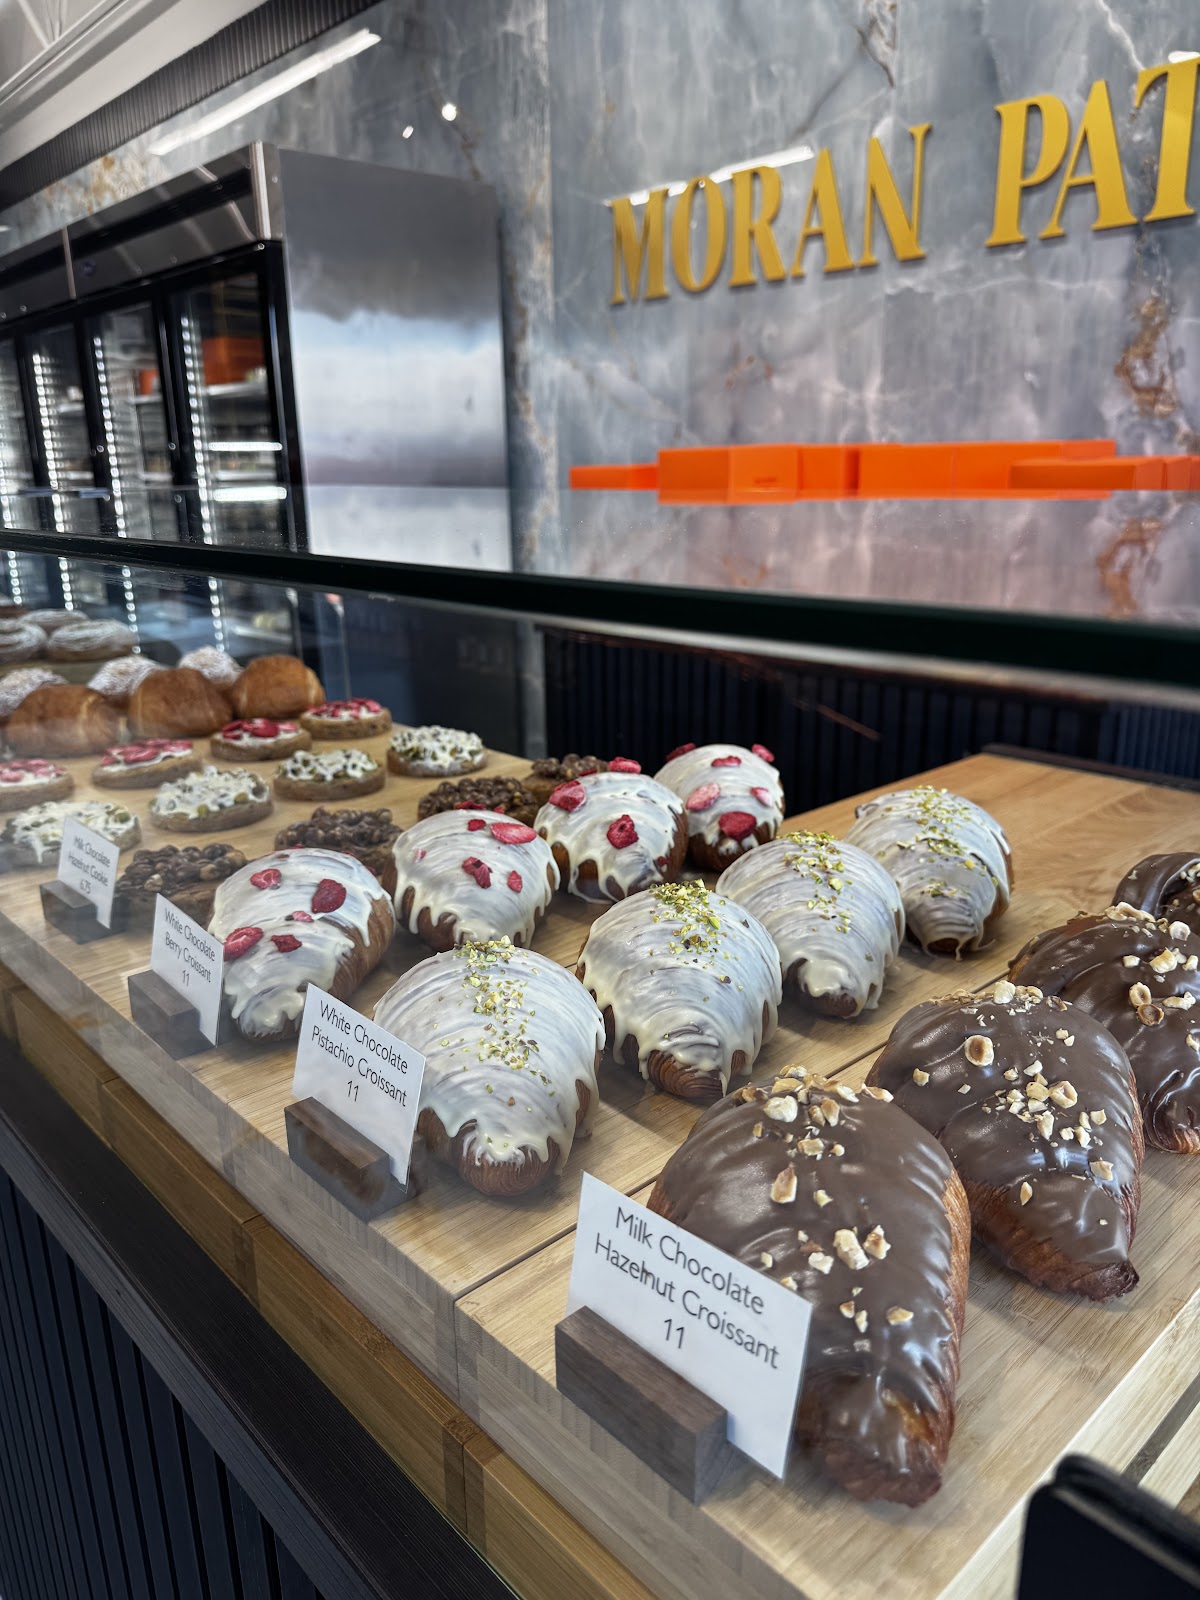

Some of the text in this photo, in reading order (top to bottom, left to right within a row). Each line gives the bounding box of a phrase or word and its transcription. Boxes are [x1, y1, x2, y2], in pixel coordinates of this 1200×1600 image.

[610, 123, 932, 305] MORAN
[68, 851, 108, 887] Hazelnut Cookie
[74, 835, 111, 868] Milk Chocolate
[165, 908, 216, 962] White Chocolate
[165, 931, 212, 983] Berry Croissant
[182, 970, 190, 987] 11
[320, 1000, 408, 1075] White Chocolate
[311, 1025, 408, 1107] Pistachio Croissant
[347, 1080, 359, 1102] 11
[615, 1206, 765, 1315] Milk Chocolate
[594, 1232, 780, 1370] Hazelnut Croissant
[663, 1318, 686, 1349] 11
